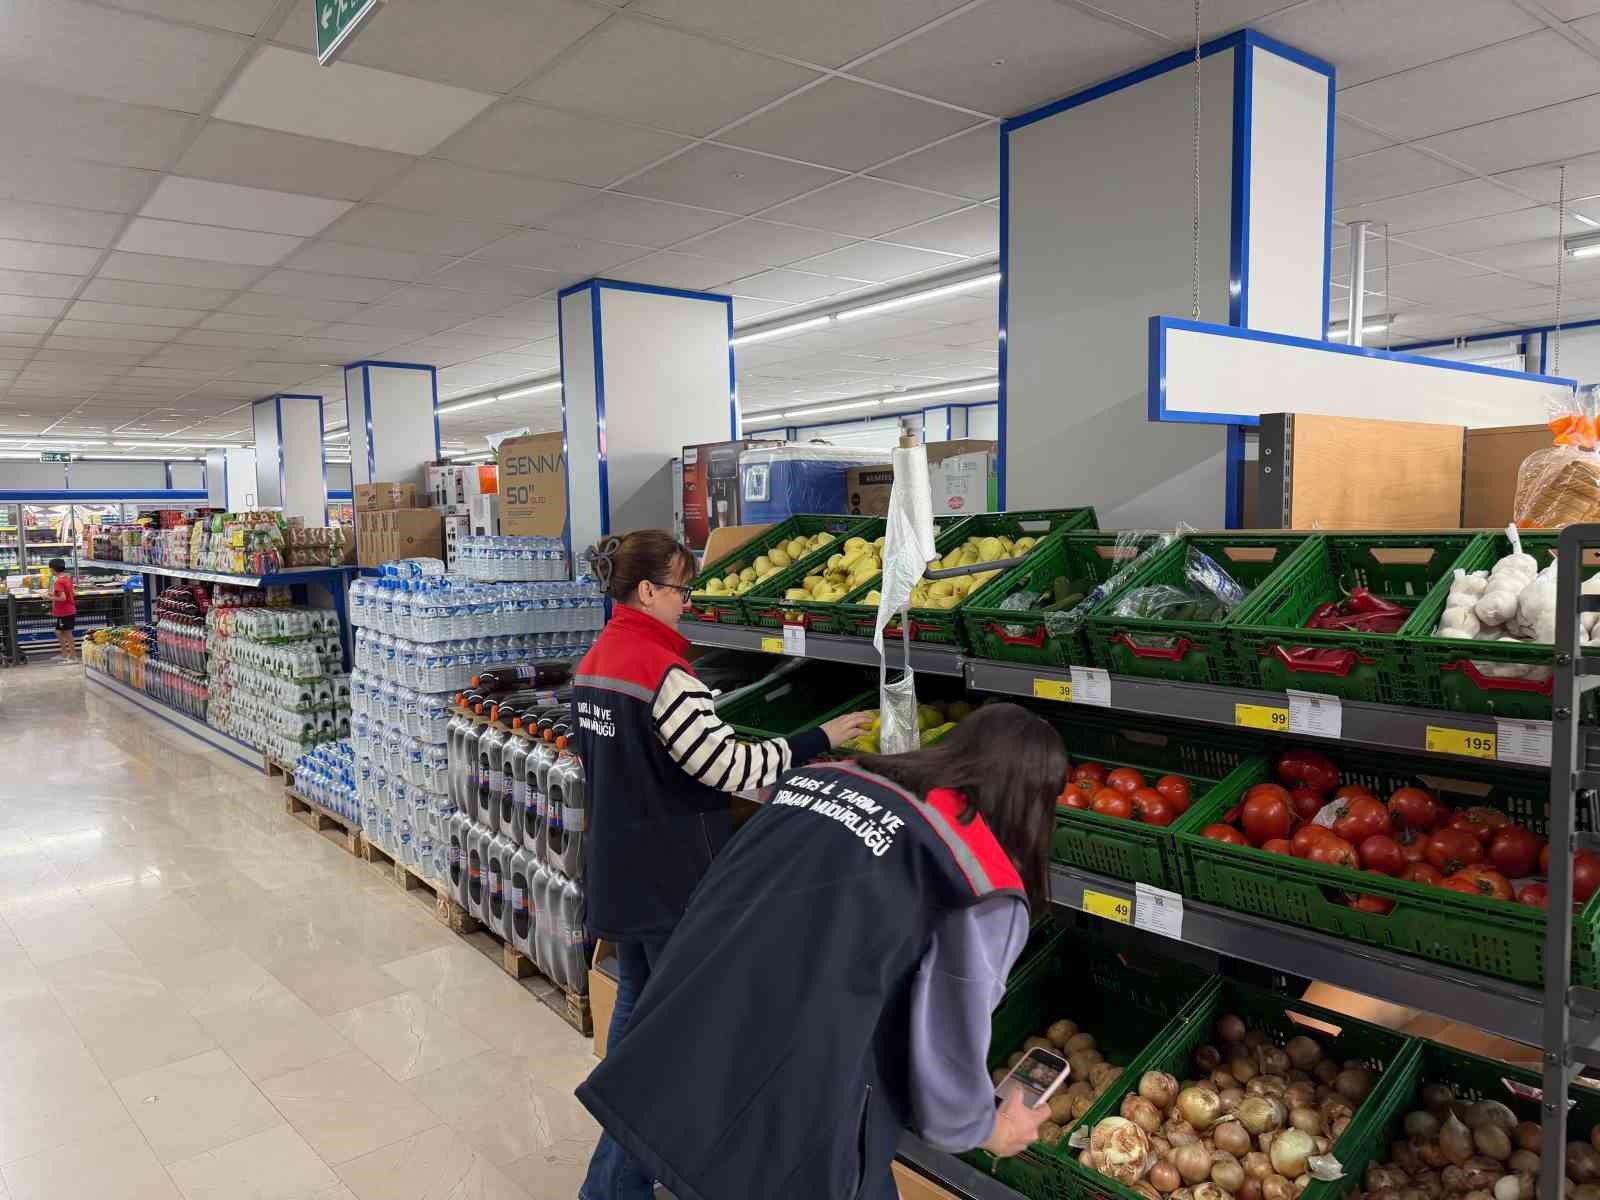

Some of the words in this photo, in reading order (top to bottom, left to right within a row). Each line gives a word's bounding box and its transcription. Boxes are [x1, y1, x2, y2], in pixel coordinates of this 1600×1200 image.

[1059, 686, 1070, 696] 39
[1271, 712, 1286, 724] 99
[1463, 736, 1492, 751] 195
[786, 775, 824, 791] KARS
[837, 788, 883, 815] TARIM
[880, 810, 905, 835] VE
[1114, 903, 1128, 916] 49
